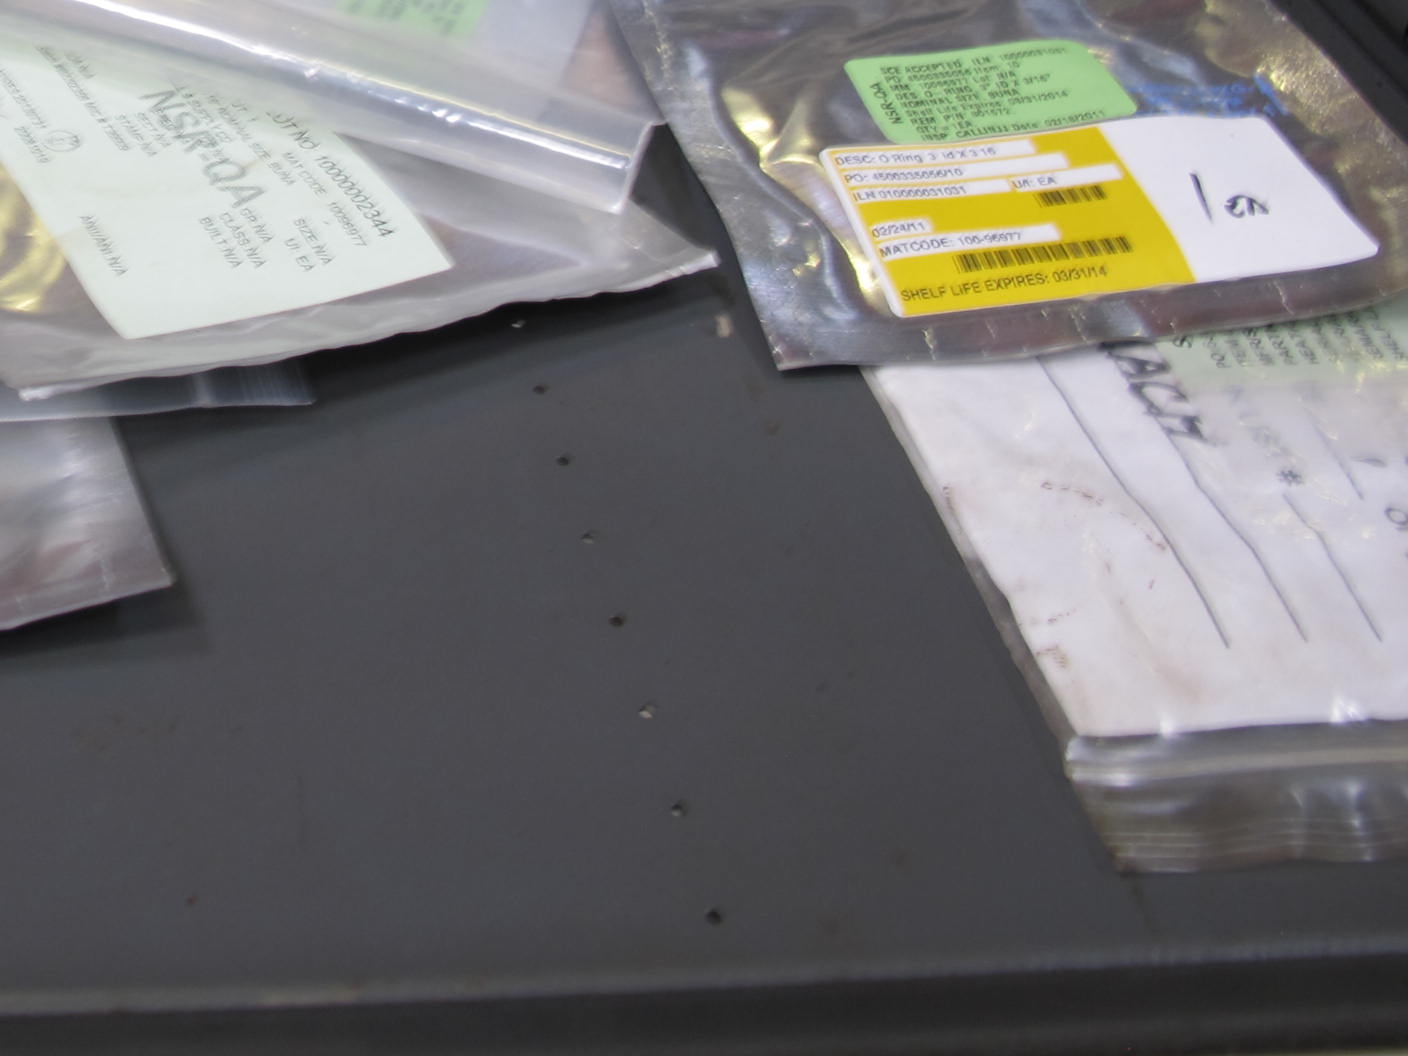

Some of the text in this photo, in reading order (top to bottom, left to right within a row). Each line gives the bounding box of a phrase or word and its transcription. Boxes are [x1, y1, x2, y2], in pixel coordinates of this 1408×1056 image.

[869, 82, 903, 125] NSR-QA
[290, 127, 320, 151] NO
[892, 151, 924, 164] Ring
[879, 237, 952, 258] MATCODE:
[900, 265, 1109, 302] SHELF LIFE EXPIRES: 03/31/14
